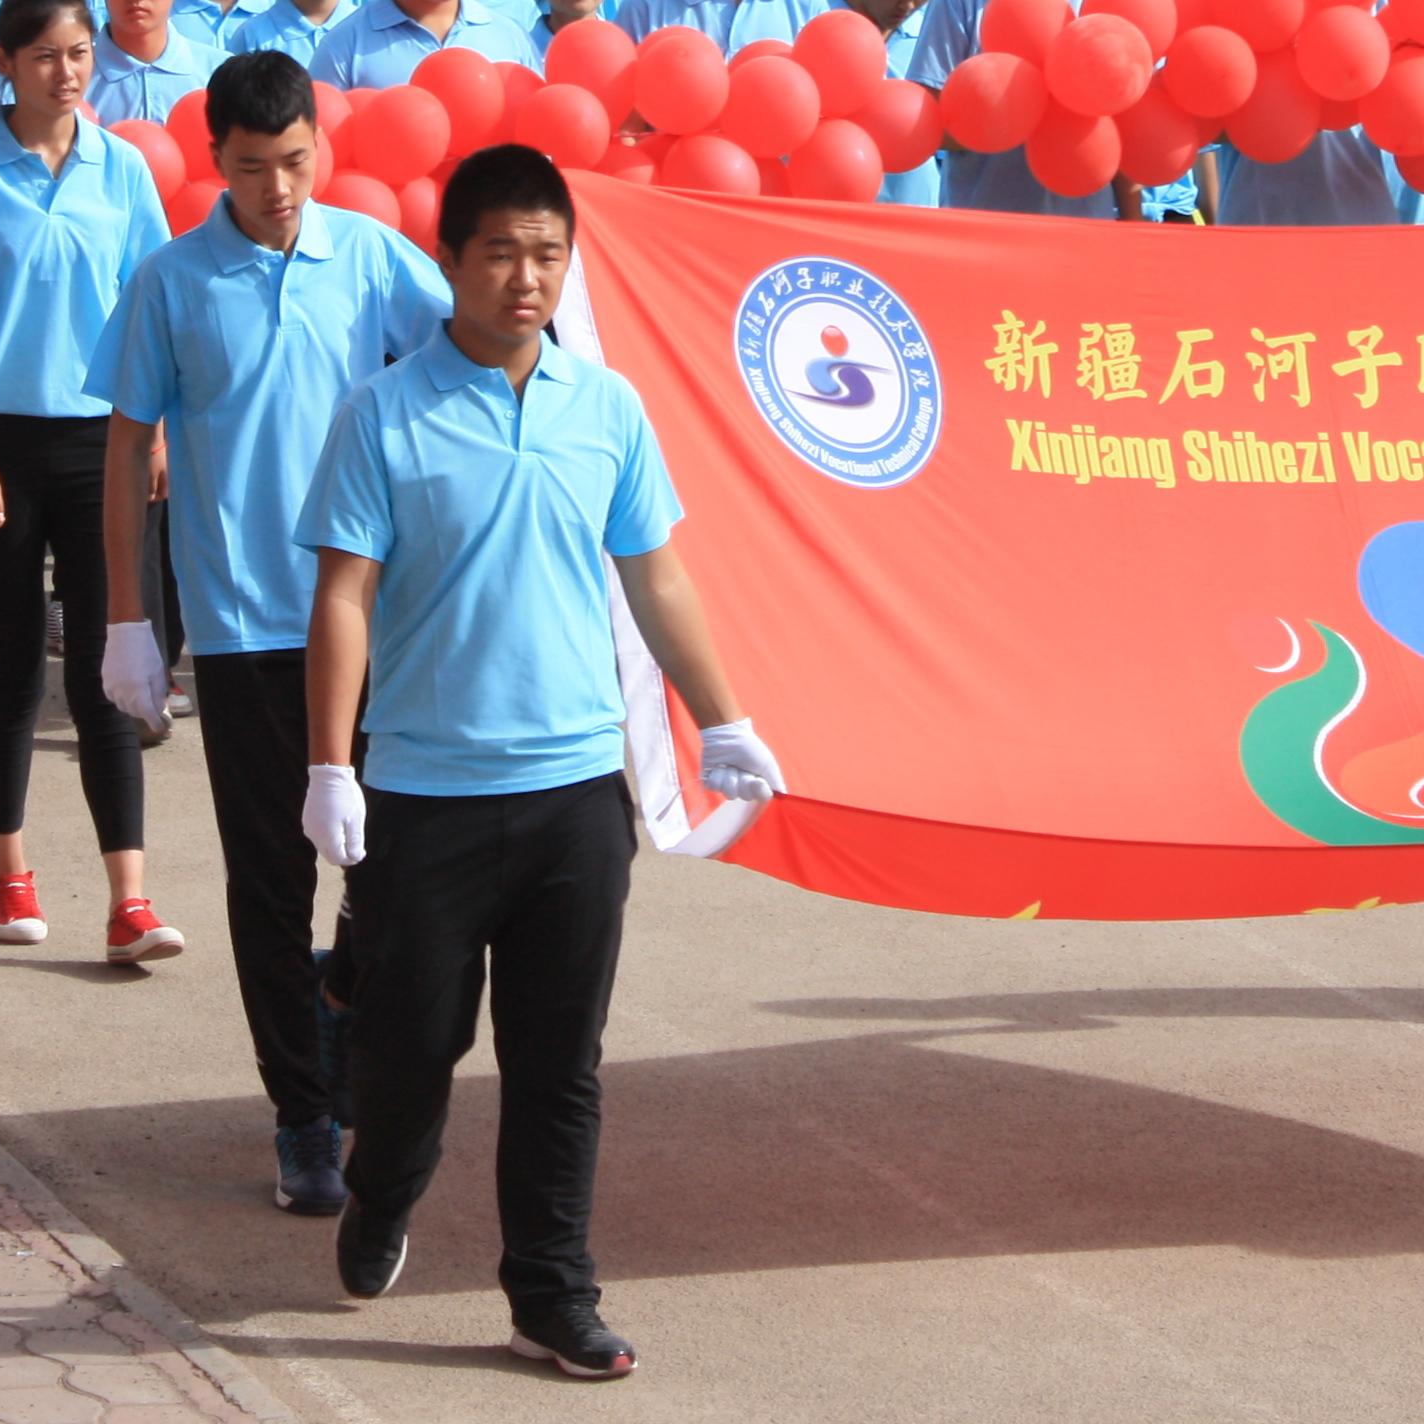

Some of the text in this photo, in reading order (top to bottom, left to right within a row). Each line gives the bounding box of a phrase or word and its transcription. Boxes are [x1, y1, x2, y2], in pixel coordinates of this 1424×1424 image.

[748, 368, 933, 477] Xinjiang Shihezi Vocational Technical College
[1005, 419, 1177, 489] Xinjiang
[1182, 429, 1337, 484] Shihezi
